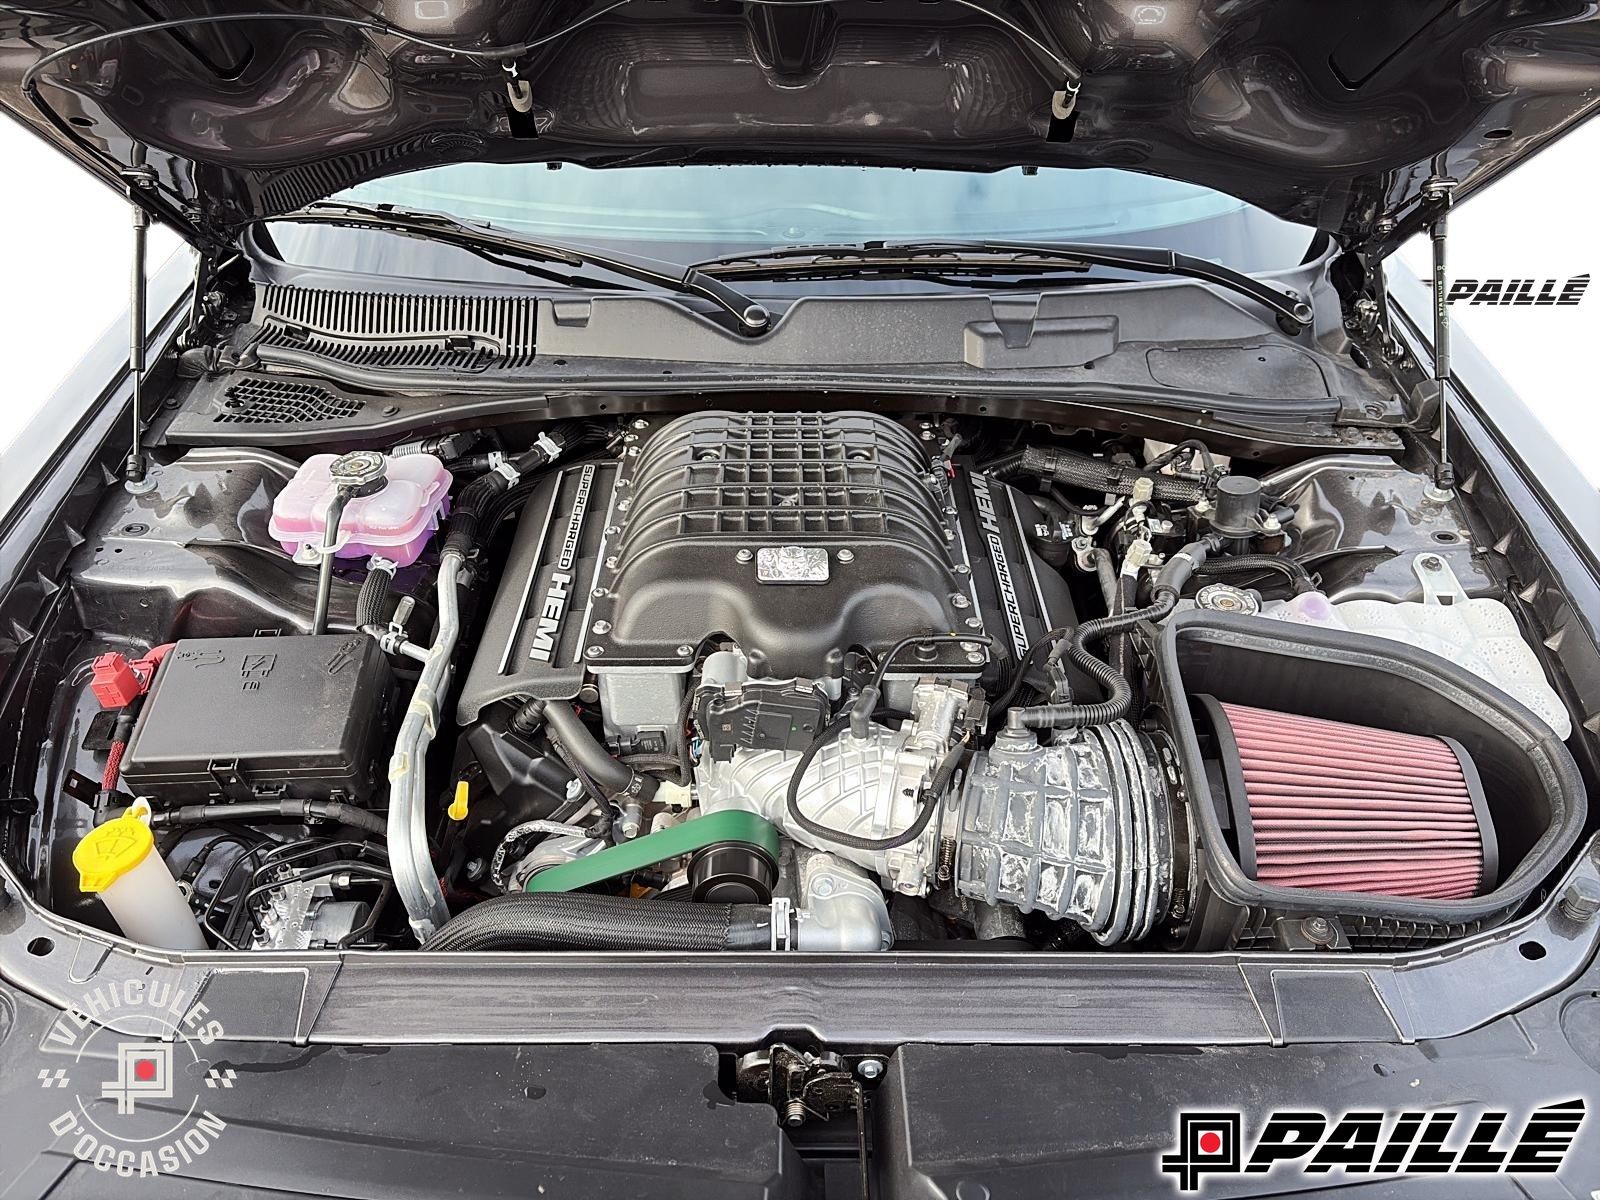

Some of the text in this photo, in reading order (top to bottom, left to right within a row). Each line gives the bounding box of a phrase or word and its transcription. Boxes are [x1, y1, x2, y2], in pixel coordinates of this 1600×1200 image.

[529, 465, 595, 662] SUPERCHARGED HEMI
[970, 471, 1000, 534] HEMI
